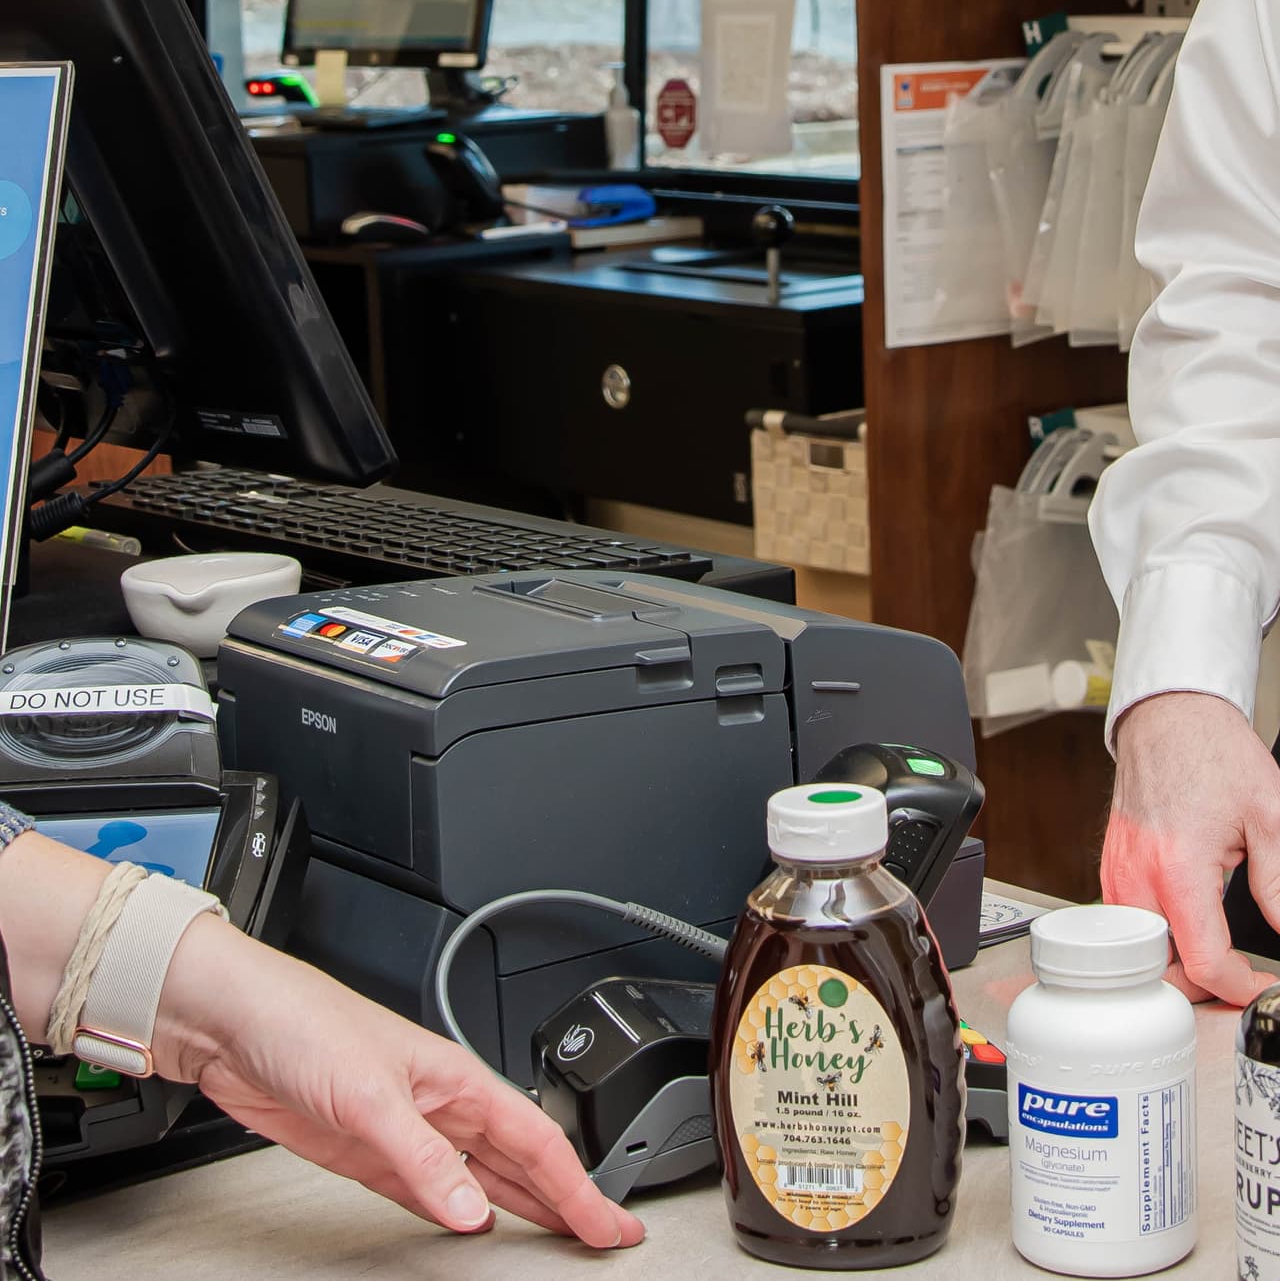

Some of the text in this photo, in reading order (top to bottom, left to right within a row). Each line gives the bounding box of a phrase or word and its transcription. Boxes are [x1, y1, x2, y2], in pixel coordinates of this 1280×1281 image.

[1022, 21, 1042, 46] H
[10, 687, 166, 711] DO NOT USE
[301, 707, 337, 735] EPSON
[765, 1006, 864, 1044] Herb's
[771, 1036, 873, 1084] Honey
[777, 1090, 858, 1108] Mint Hill
[1023, 1092, 1110, 1118] pure
[775, 1107, 790, 1116] 1.5
[793, 1108, 823, 1117] pound
[832, 1109, 844, 1117] 16
[755, 1120, 881, 1134] www.herbshoneypot.com
[783, 1134, 851, 1145] 704.763.1646
[1025, 1135, 1109, 1161] Magnesium
[1041, 1158, 1086, 1173] (glycinate)
[1140, 1095, 1152, 1232] Supplement Facts
[1028, 1208, 1105, 1230] Dietary Supplement
[1065, 1203, 1097, 1212] Non-GMO
[1052, 1227, 1085, 1239] CAPSULES
